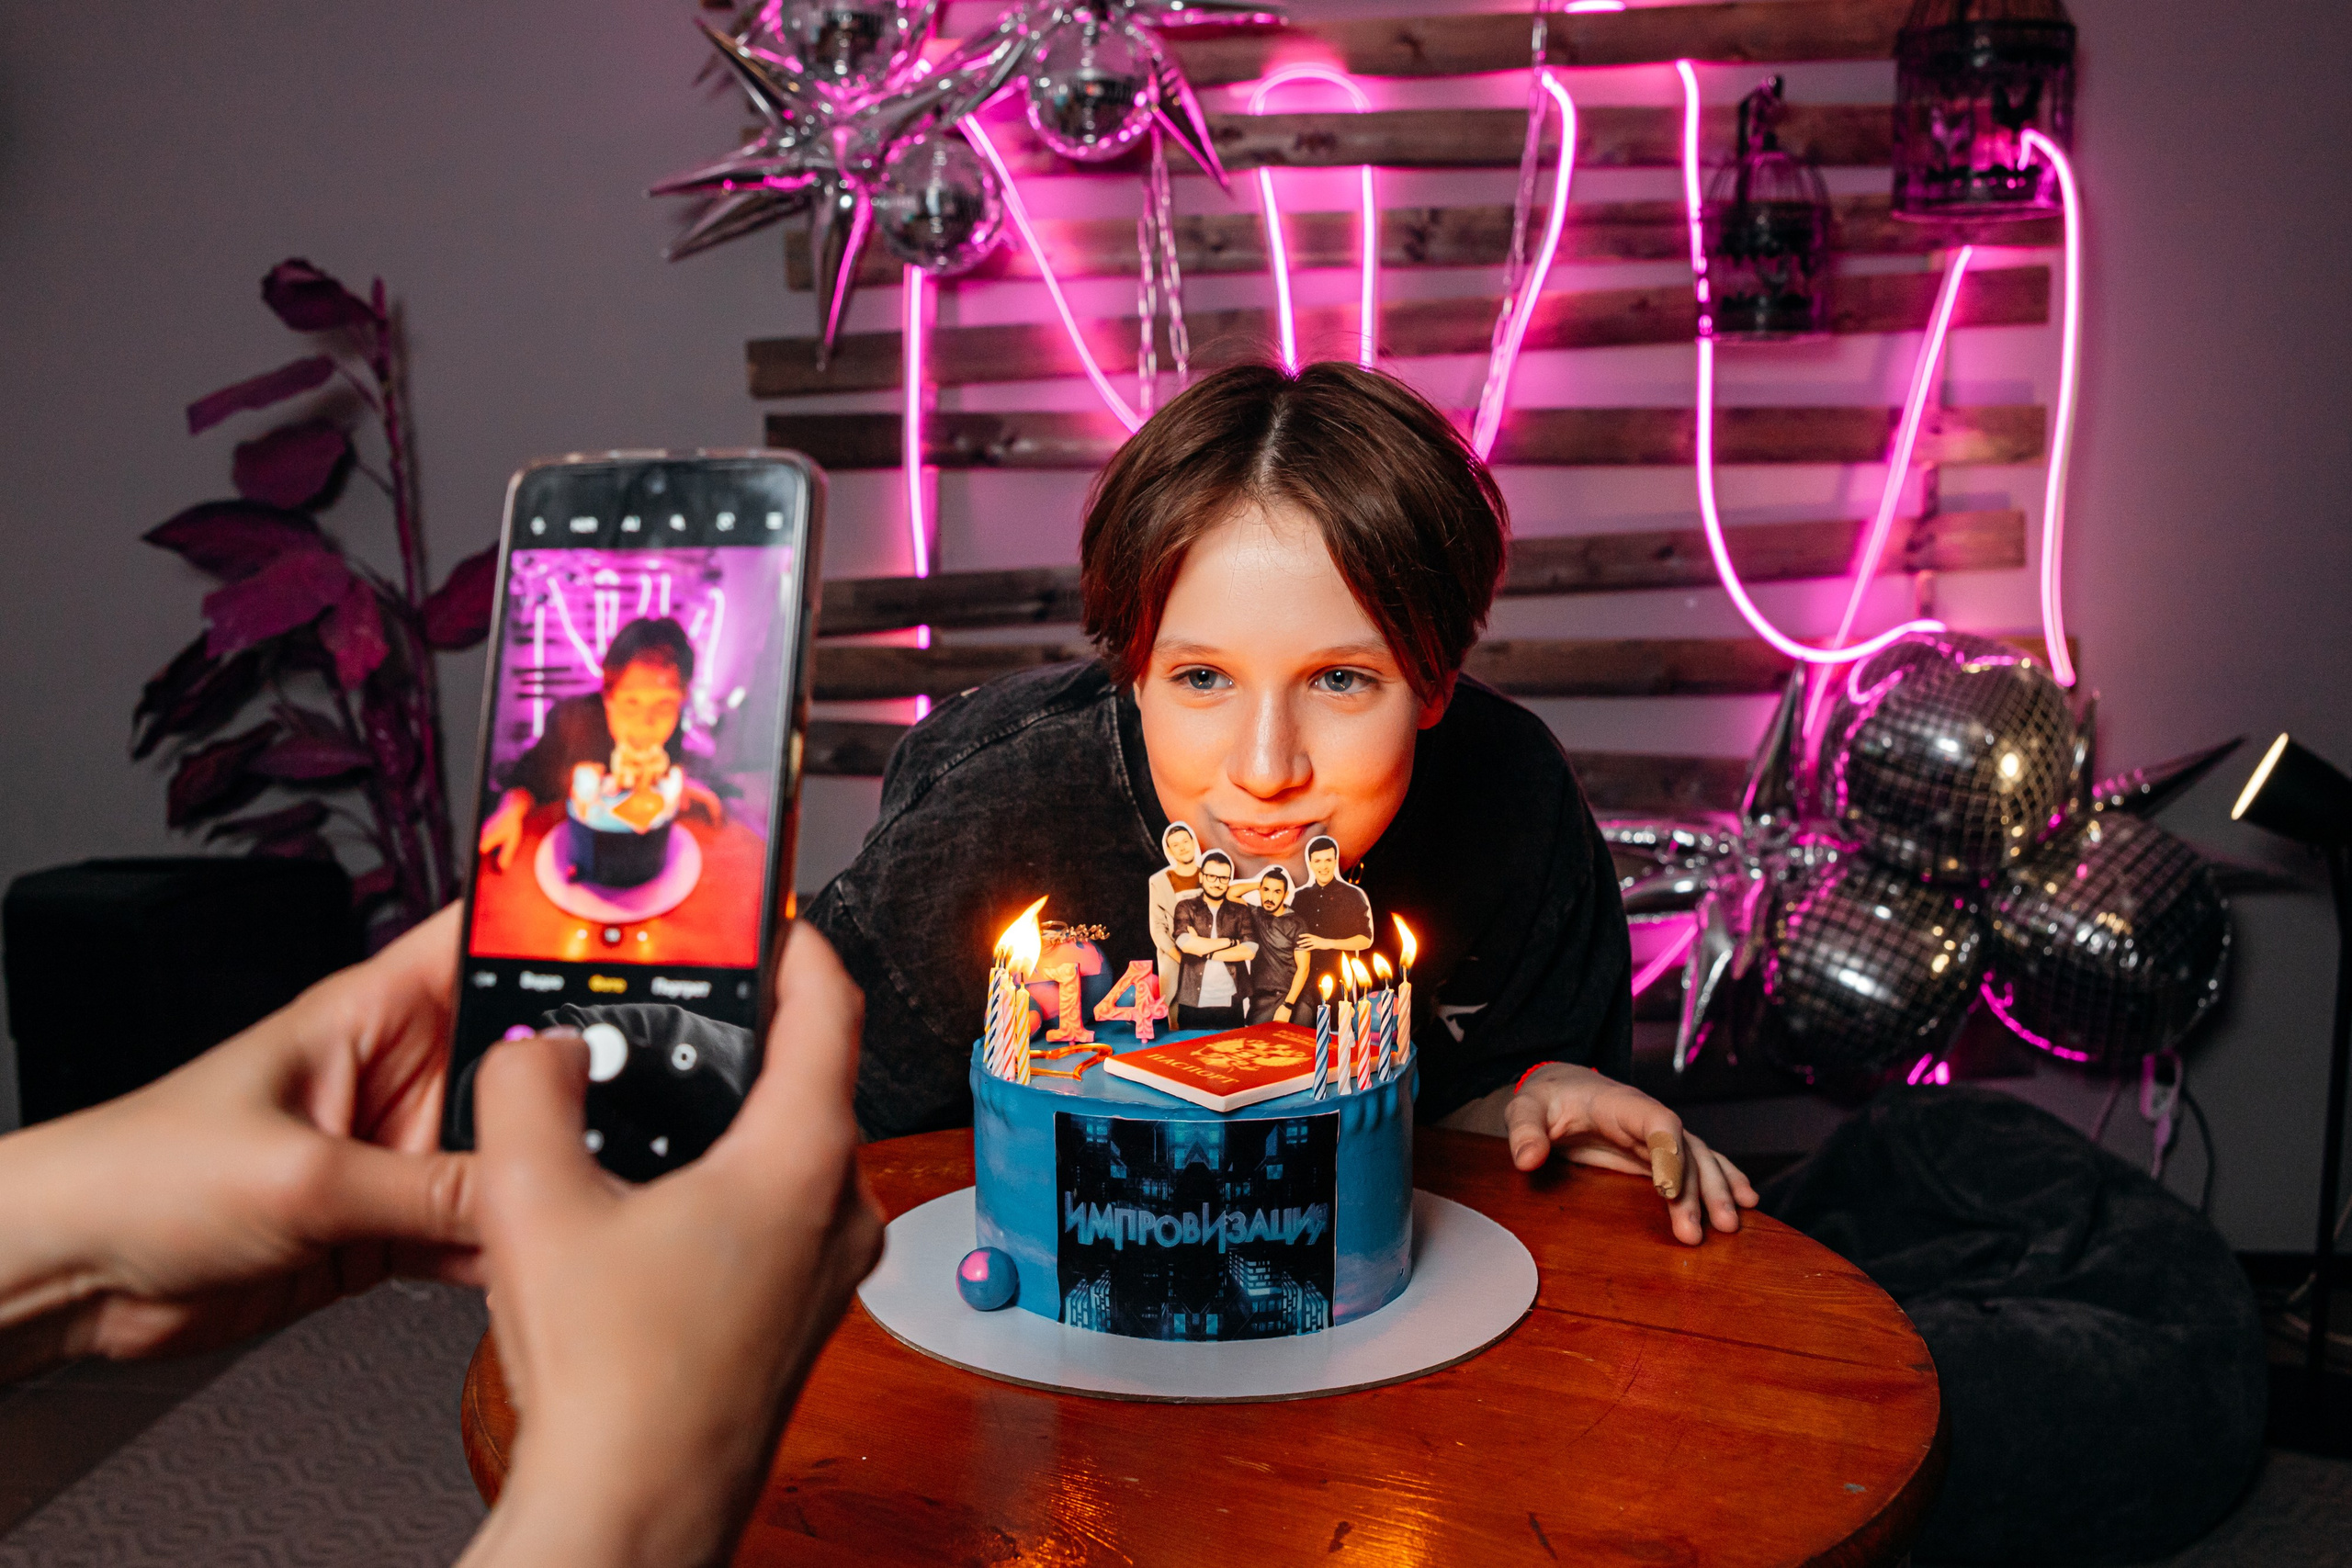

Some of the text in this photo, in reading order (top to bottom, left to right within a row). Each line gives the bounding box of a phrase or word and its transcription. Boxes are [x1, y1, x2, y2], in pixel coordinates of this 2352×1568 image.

[1041, 960, 1169, 1043] 14
[1146, 1054, 1240, 1084] ПАСПОРТ
[1064, 1190, 1329, 1254] ИМПРОВИЗАЦИЯ
